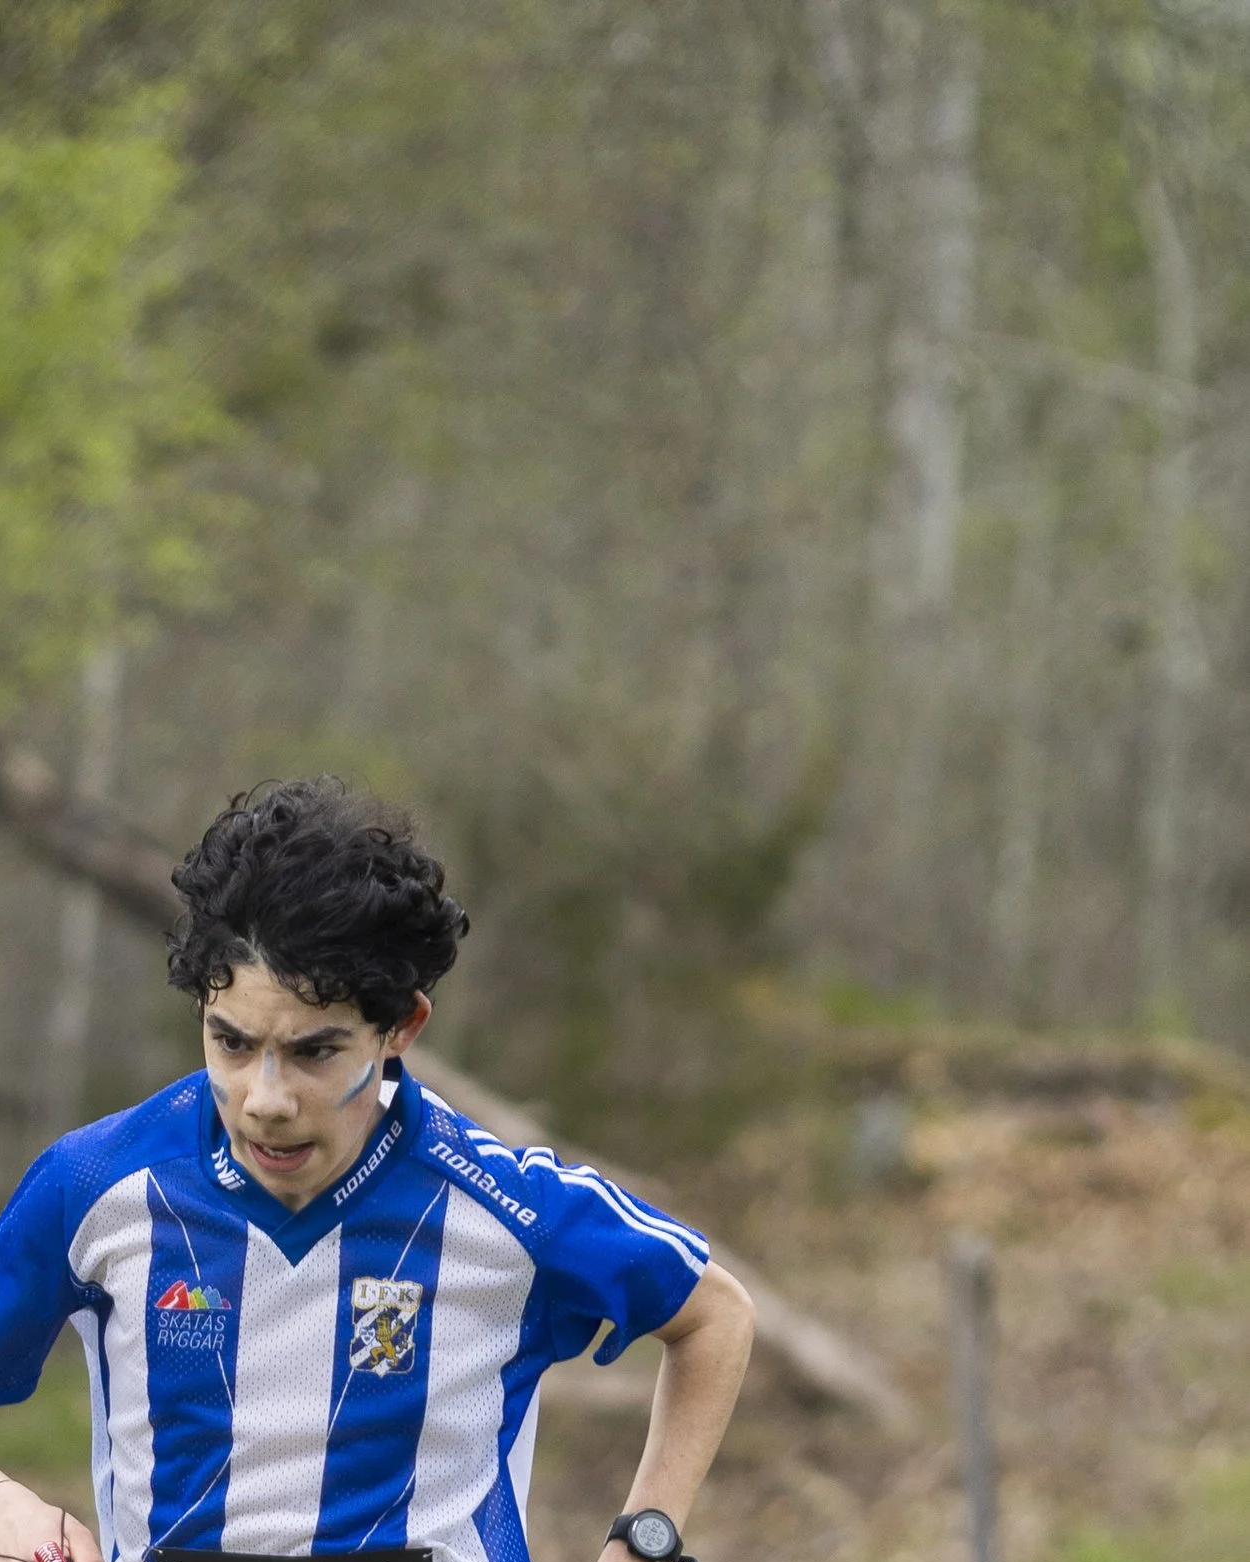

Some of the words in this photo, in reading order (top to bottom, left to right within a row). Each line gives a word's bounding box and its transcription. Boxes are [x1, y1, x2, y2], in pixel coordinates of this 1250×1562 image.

[332, 1119, 403, 1206] noname
[428, 1141, 538, 1228] noname
[157, 1329, 225, 1351] RYGGAR
